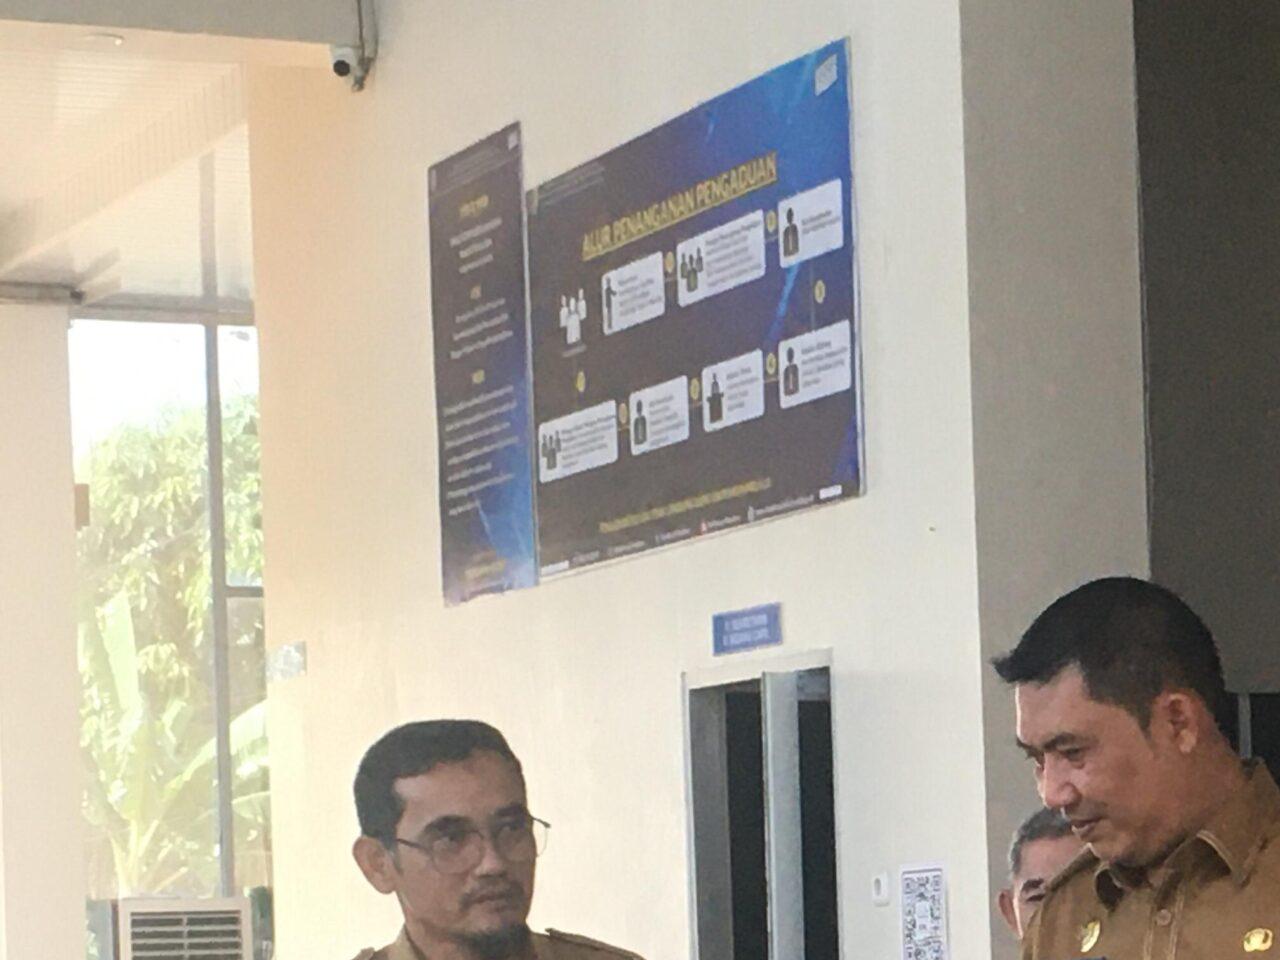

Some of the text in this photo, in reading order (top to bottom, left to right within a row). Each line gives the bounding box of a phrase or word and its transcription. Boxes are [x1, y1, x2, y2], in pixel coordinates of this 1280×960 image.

[583, 152, 777, 260] ALUR PENANGANAN PENGADUAN
